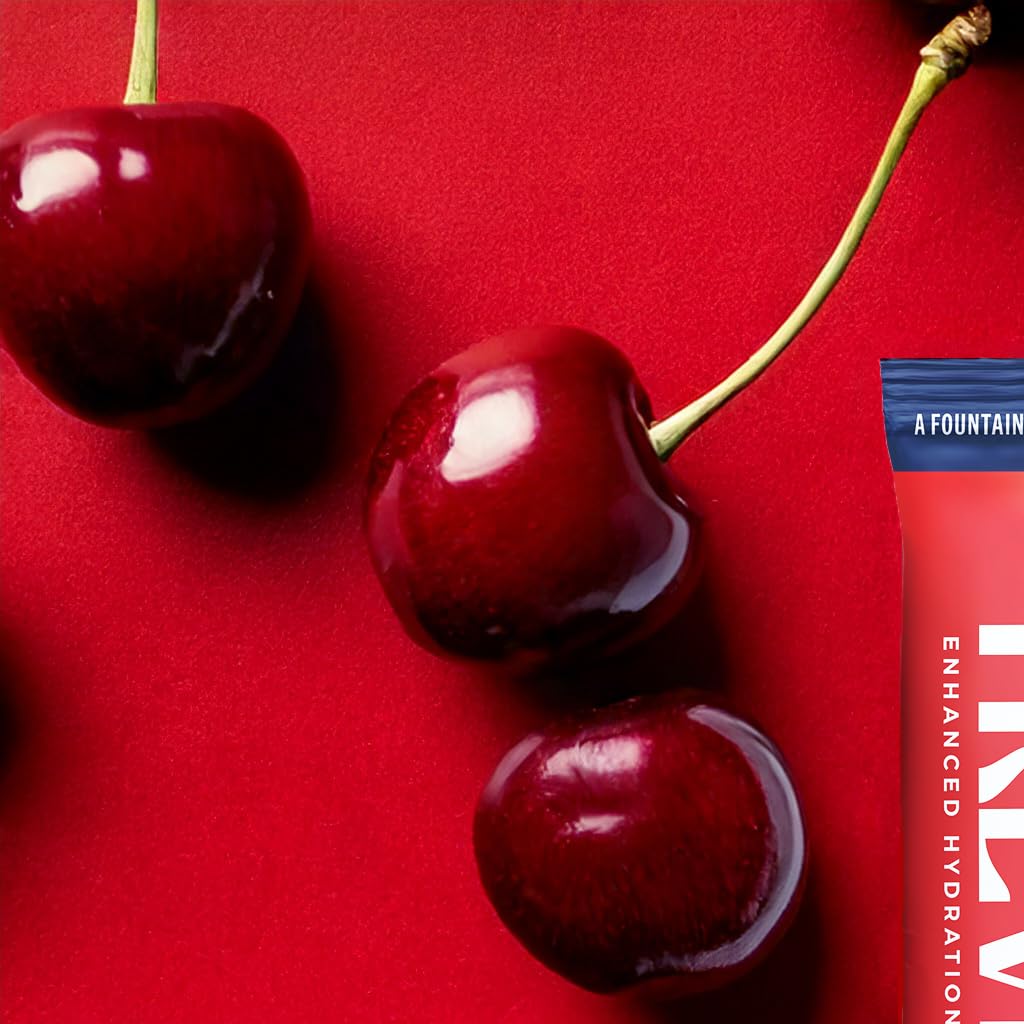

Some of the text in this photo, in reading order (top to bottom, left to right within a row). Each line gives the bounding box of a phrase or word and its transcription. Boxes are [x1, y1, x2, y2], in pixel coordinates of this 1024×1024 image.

[914, 413, 926, 436] A
[931, 413, 1024, 436] FOUNTAIN
[942, 636, 960, 817] ENHANCED
